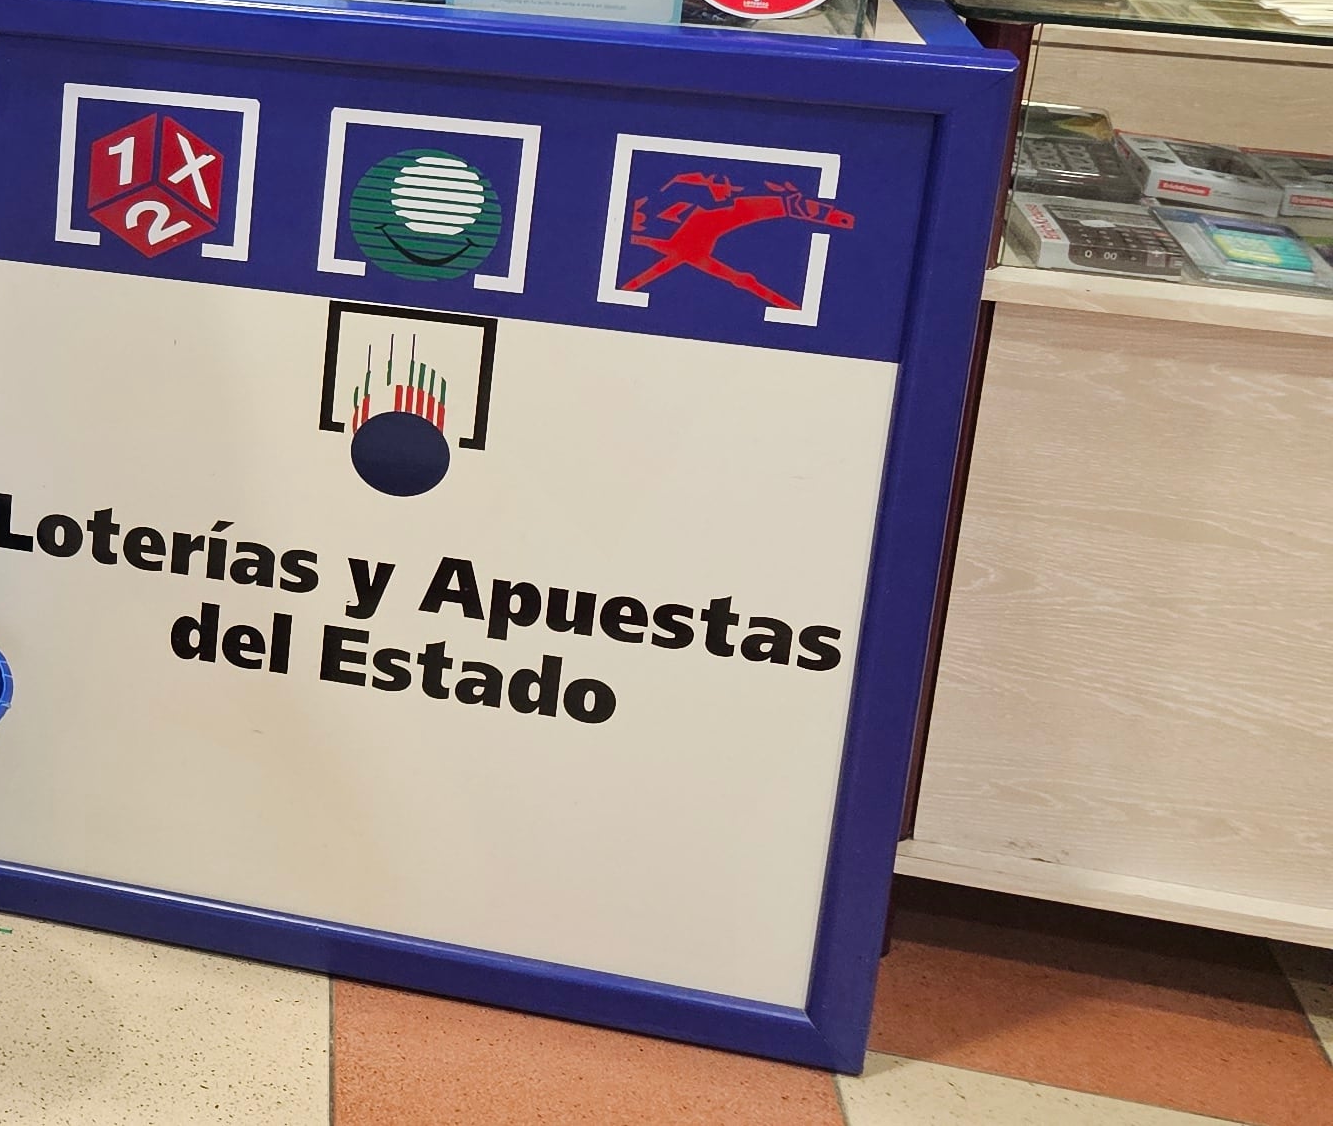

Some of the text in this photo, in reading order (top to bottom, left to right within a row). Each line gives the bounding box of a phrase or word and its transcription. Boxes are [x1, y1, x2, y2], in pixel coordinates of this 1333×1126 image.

[170, 603, 618, 726] del Estado
[344, 555, 395, 620] y
[418, 556, 844, 675] Apuestas
